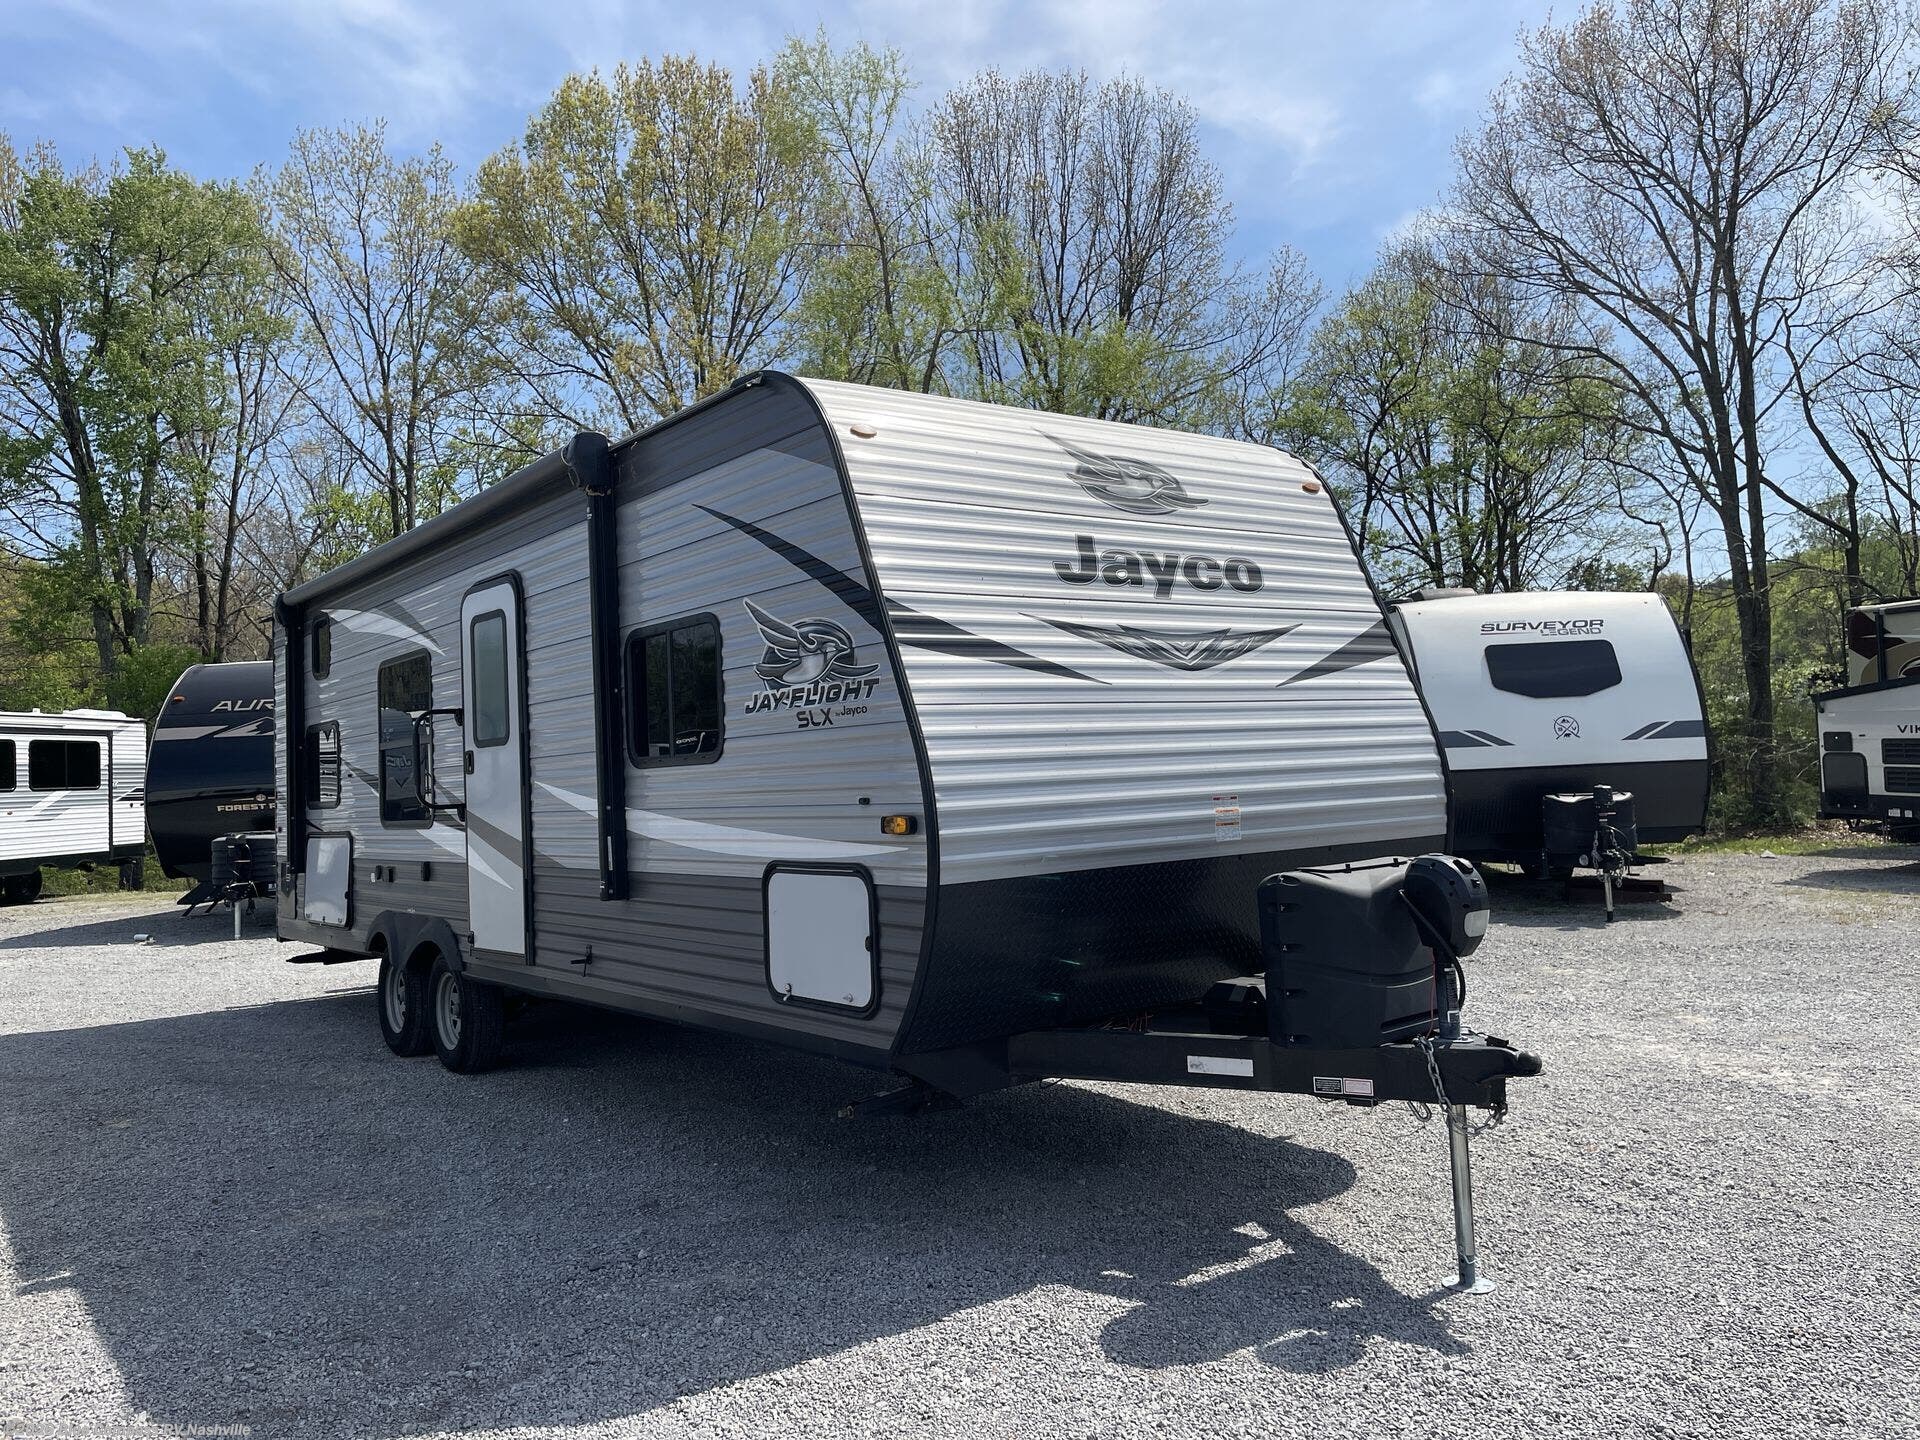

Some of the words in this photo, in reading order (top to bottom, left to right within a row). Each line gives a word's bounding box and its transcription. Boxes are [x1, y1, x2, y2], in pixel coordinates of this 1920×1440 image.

[1052, 533, 1264, 600] Jayco
[1480, 619, 1604, 632] SURVEYOR
[1541, 627, 1602, 636] LEGEND
[796, 707, 834, 728] SLX
[840, 705, 868, 717] Jayco
[216, 803, 267, 812] FOREST
